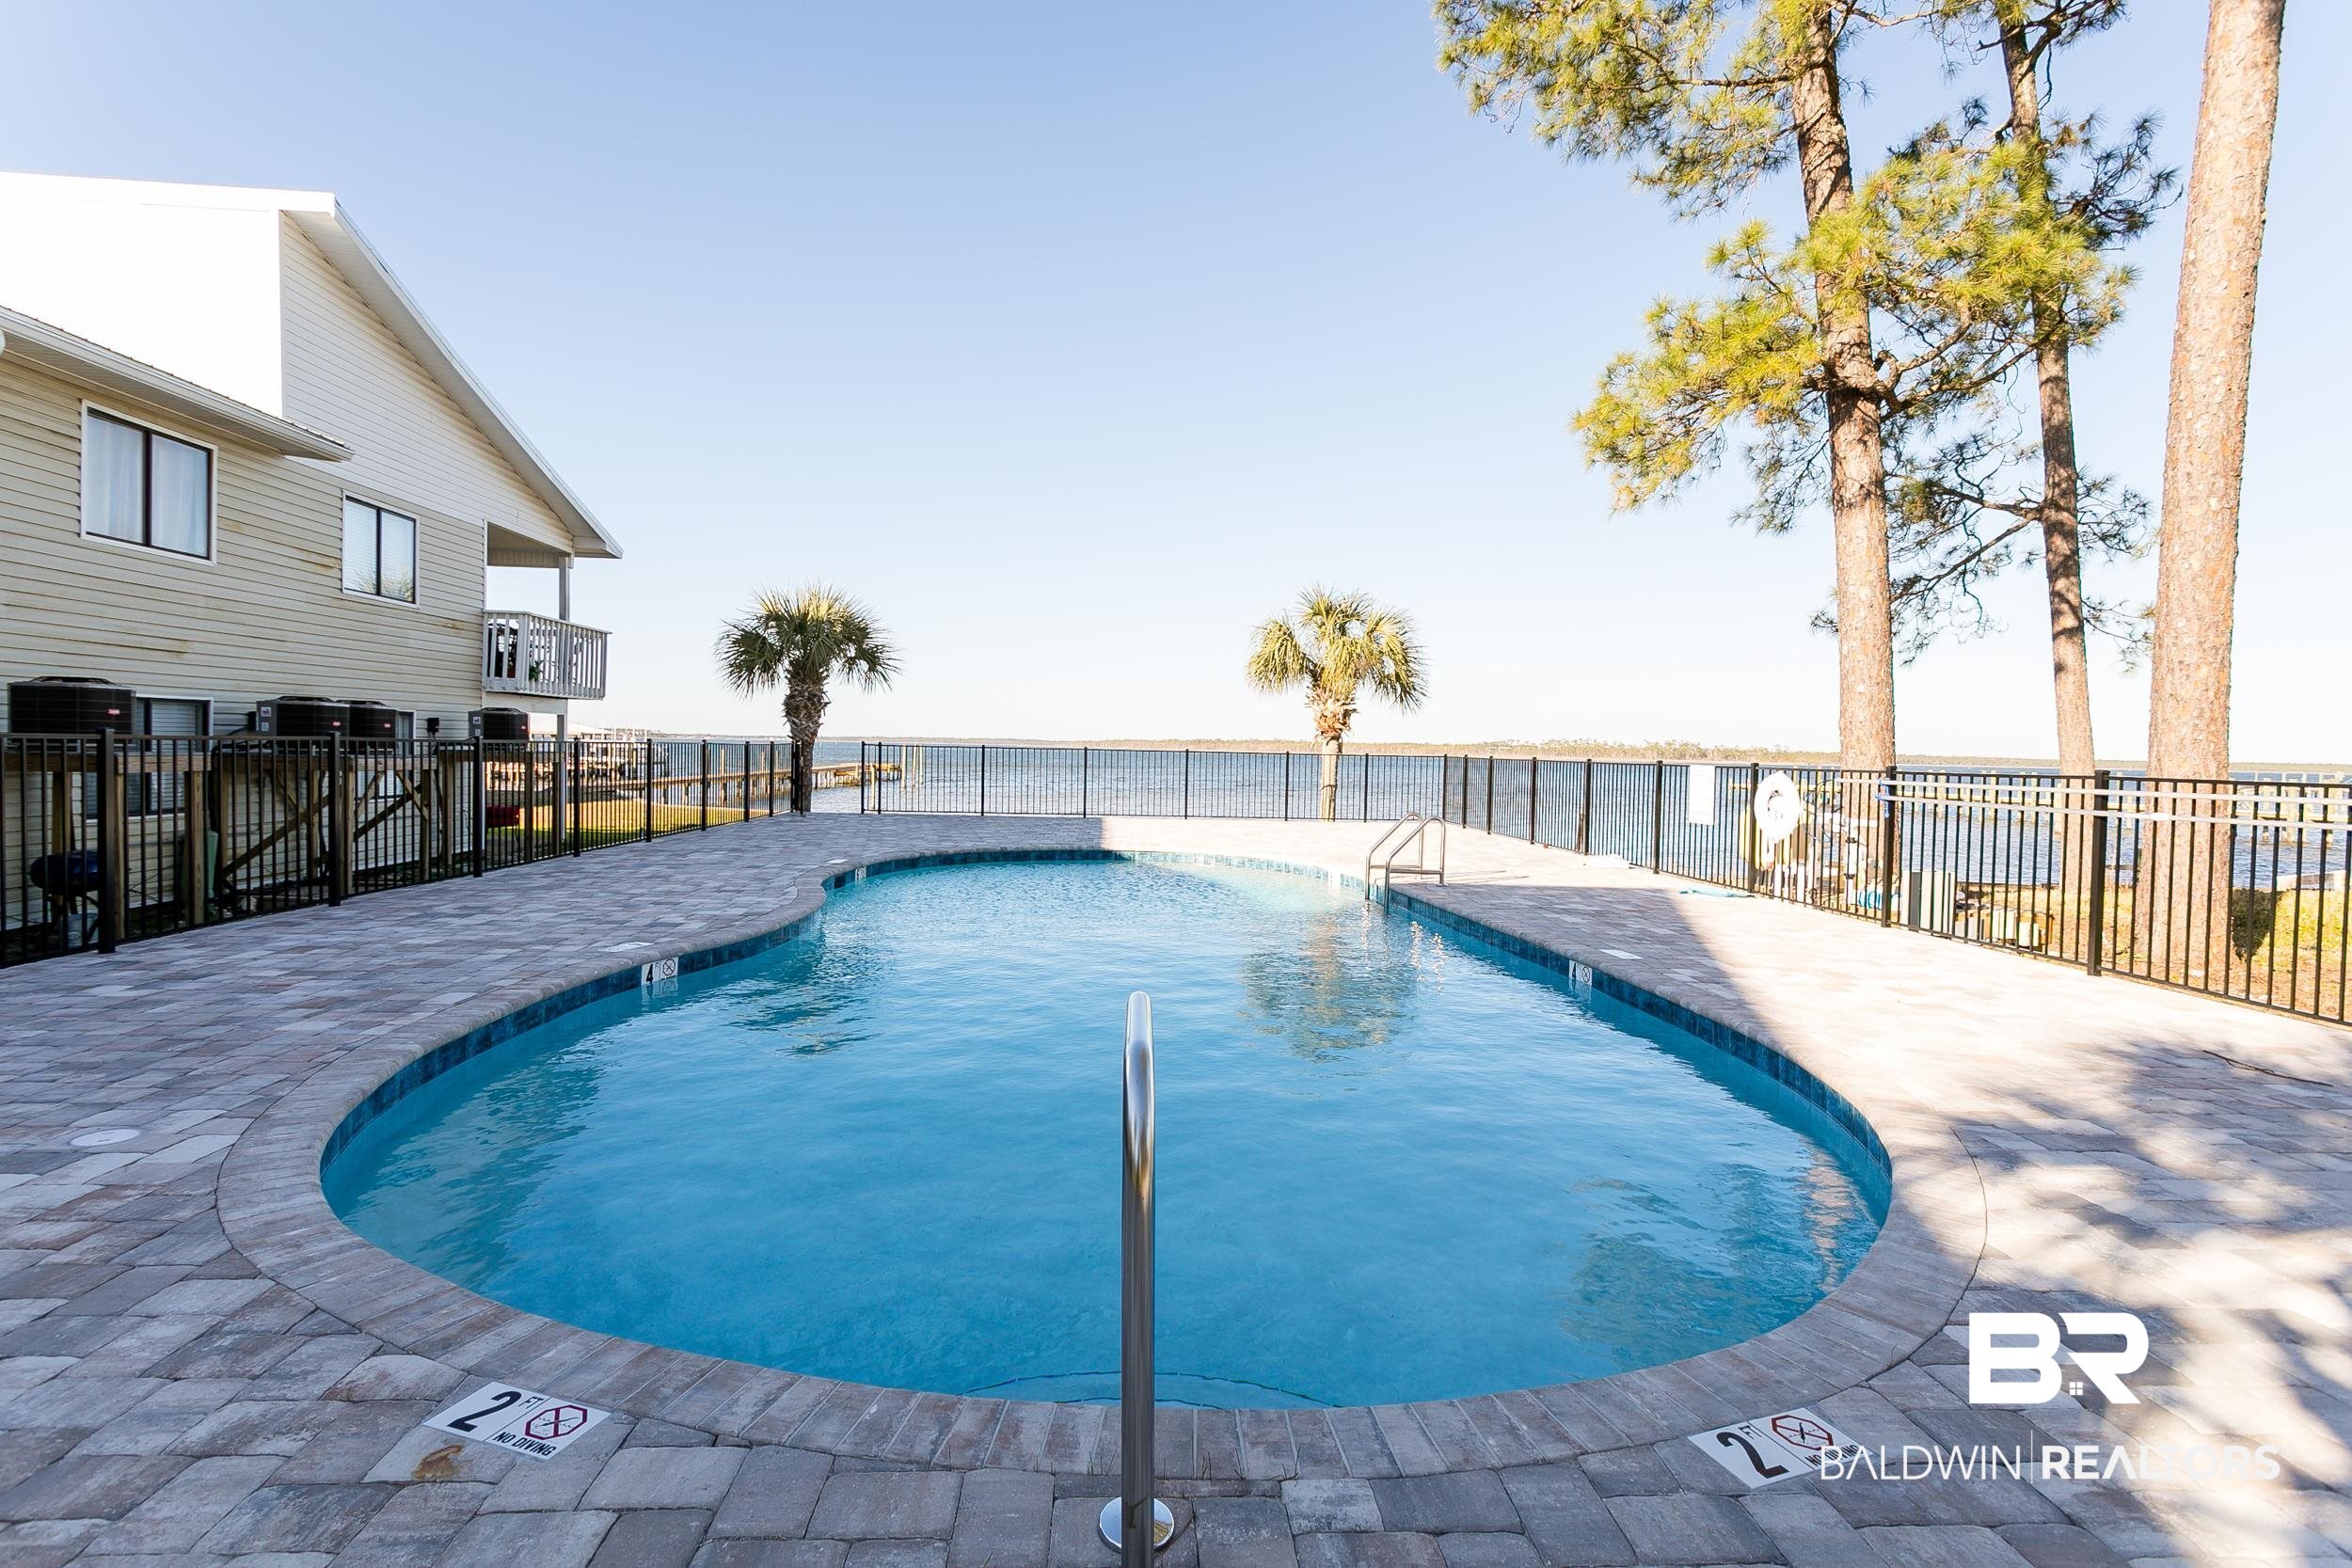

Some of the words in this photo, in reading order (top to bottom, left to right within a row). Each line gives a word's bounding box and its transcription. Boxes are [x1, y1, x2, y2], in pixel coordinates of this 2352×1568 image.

[446, 1390, 522, 1433] 2
[517, 1396, 545, 1410] FT
[492, 1431, 516, 1444] NO
[511, 1436, 557, 1457] DIVING
[1738, 1425, 1763, 1440] FT
[1715, 1432, 1791, 1480] 2
